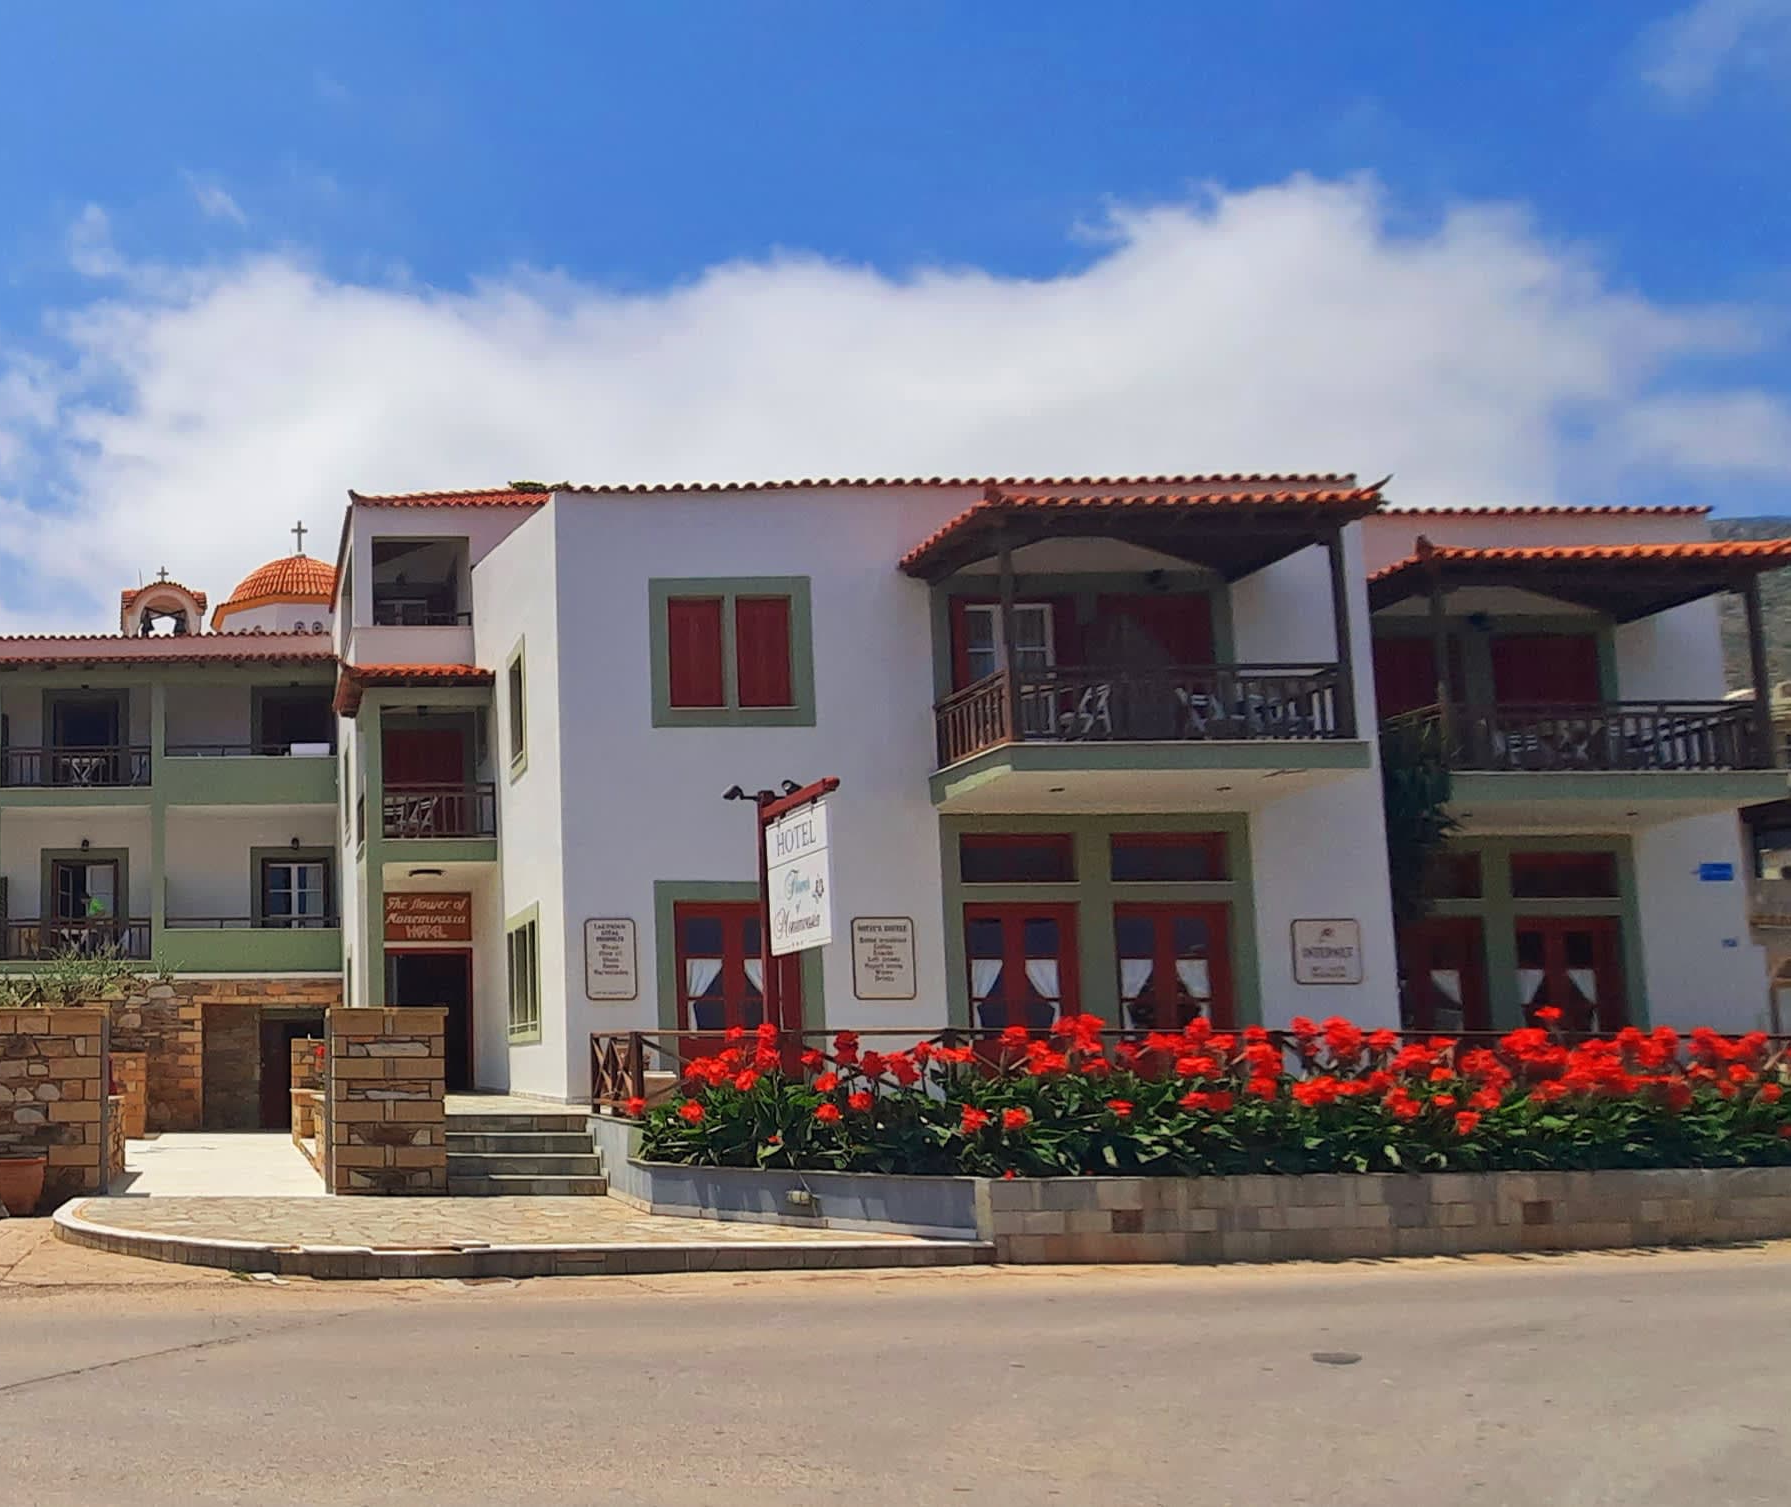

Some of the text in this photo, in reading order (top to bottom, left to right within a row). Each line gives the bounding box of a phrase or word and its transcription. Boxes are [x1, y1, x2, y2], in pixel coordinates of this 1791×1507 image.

[776, 819, 816, 857] HOTEL
[385, 897, 409, 910] The
[452, 897, 469, 911] of
